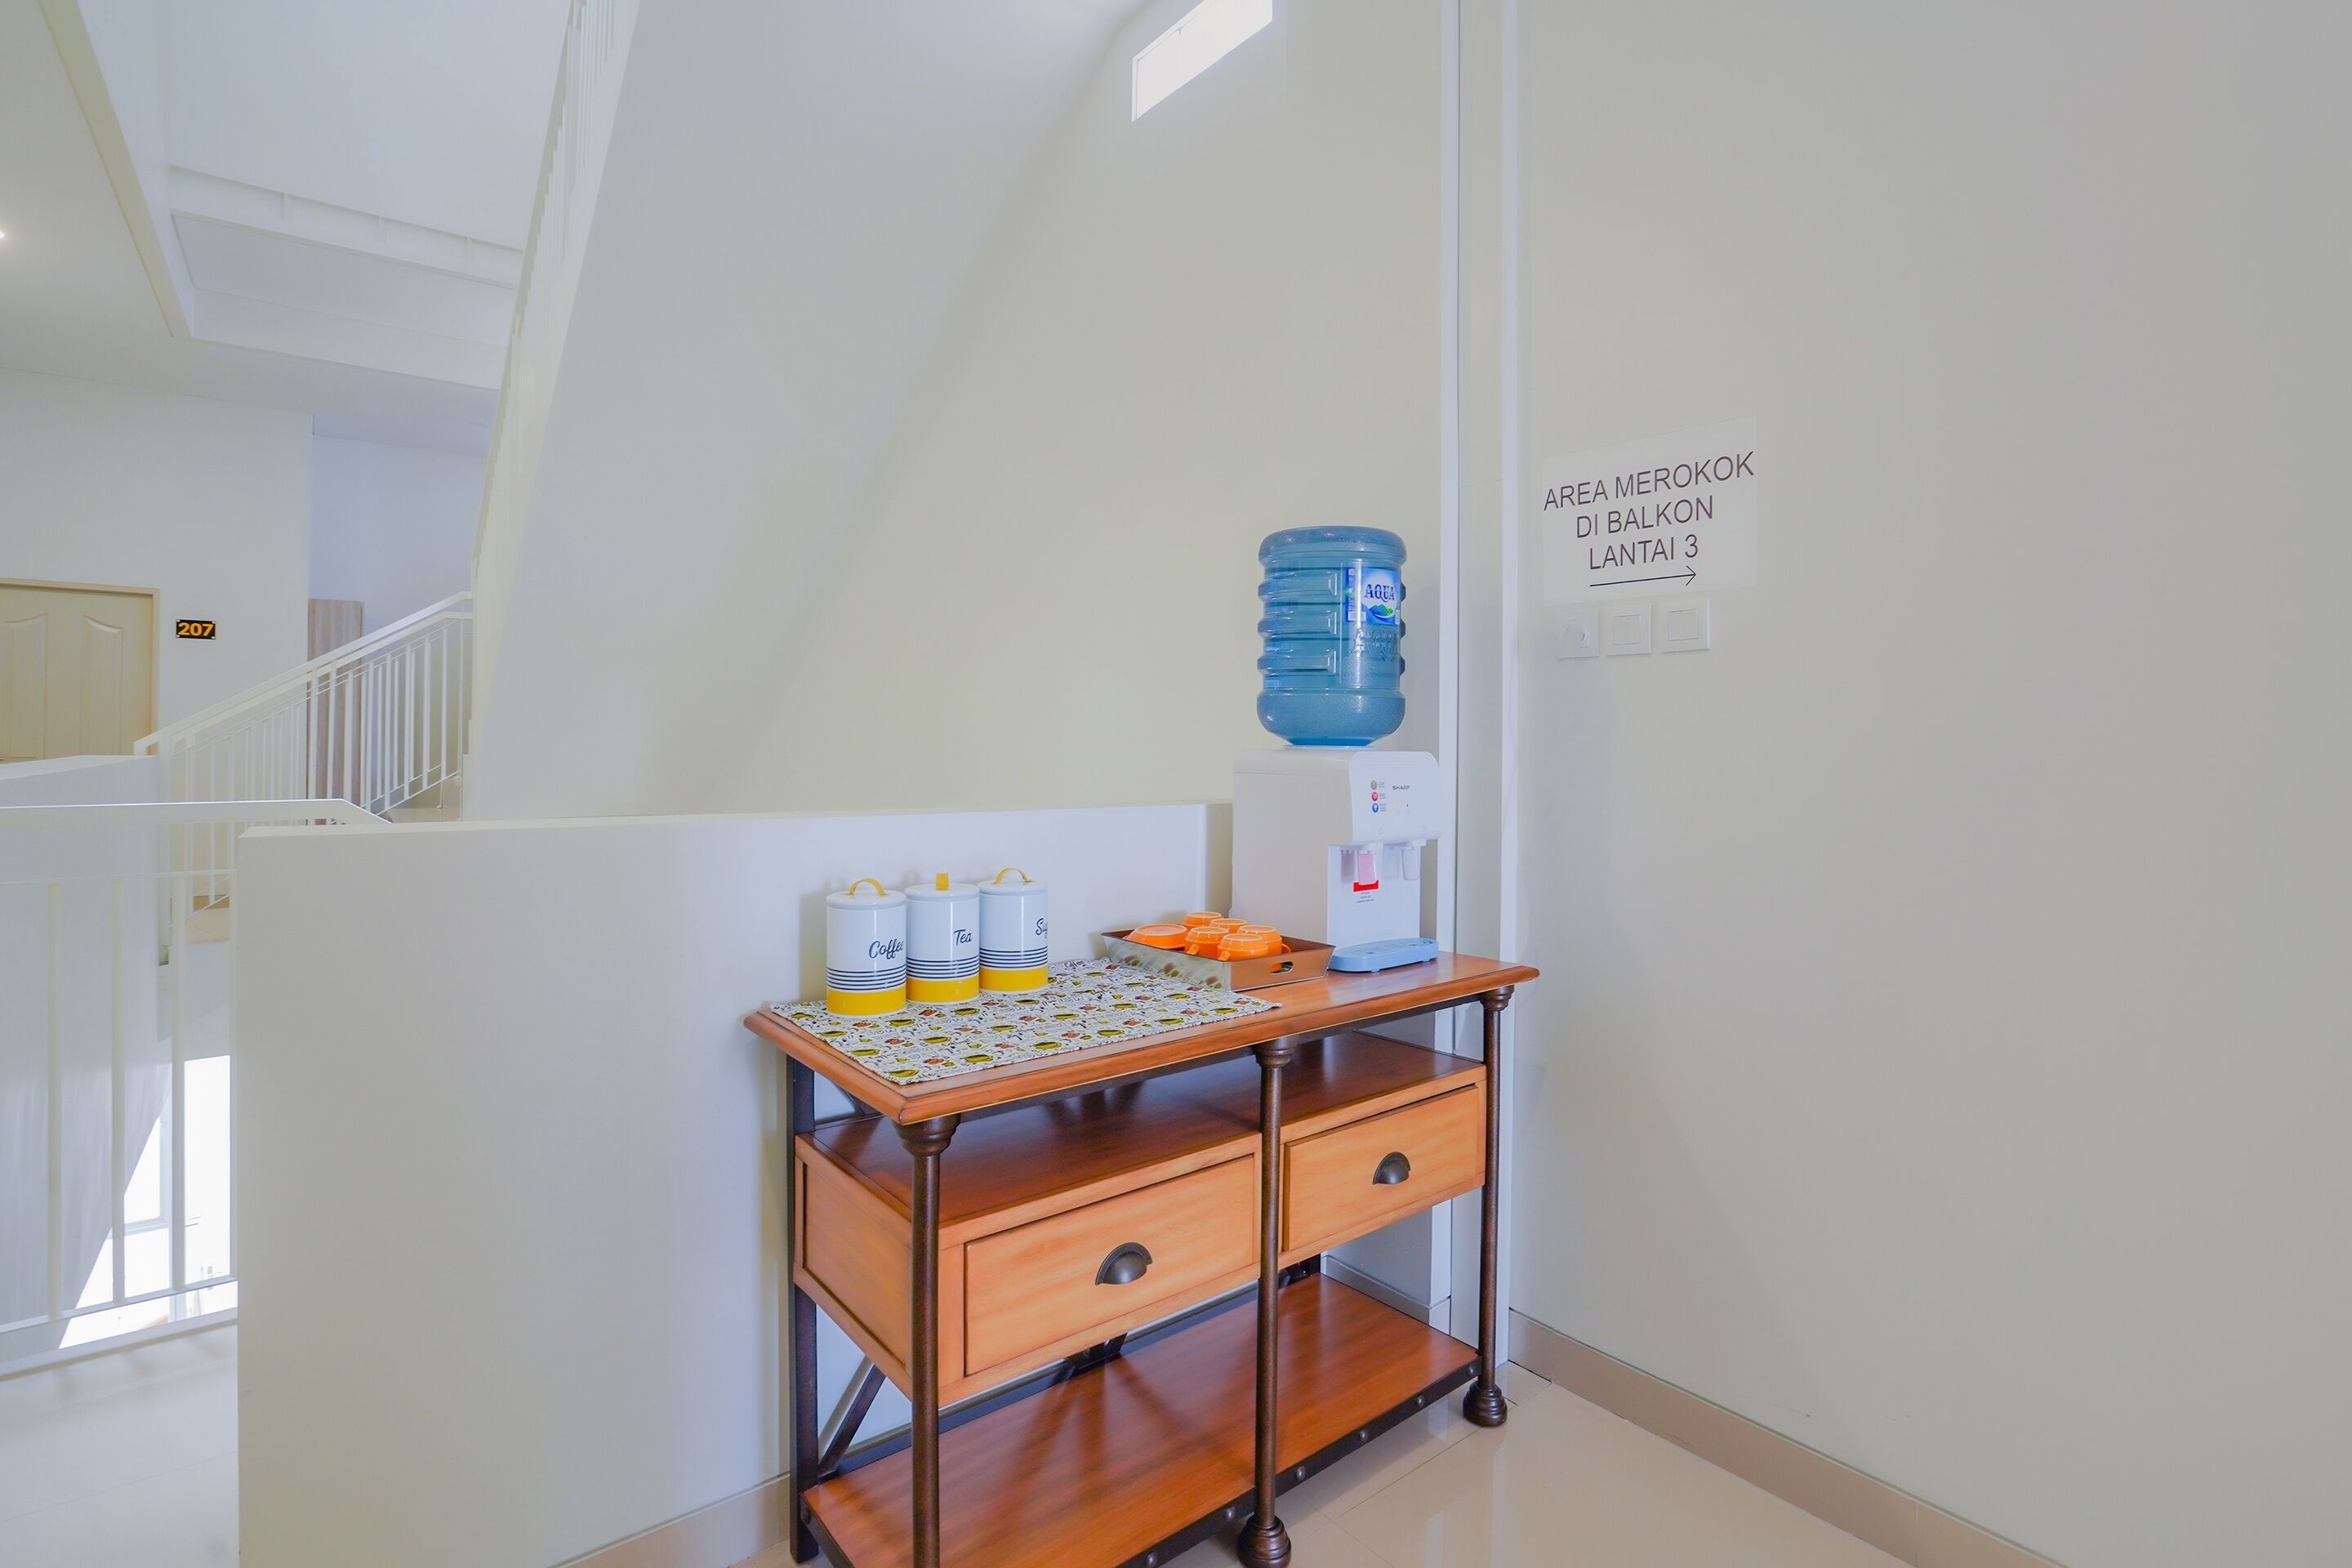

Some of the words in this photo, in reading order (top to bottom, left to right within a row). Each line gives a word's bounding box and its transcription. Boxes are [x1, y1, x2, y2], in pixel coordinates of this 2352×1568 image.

[1544, 479, 1608, 510] AREA
[1615, 451, 1754, 499] MEROKOK
[1577, 514, 1598, 538] DI
[1608, 495, 1713, 533] BALKON
[1589, 537, 1674, 570] LANTAI
[1685, 534, 1699, 558] 3
[1365, 584, 1394, 603] AQUA
[178, 622, 214, 636] 207
[953, 929, 972, 946] Tea
[869, 938, 904, 960] Coffee
